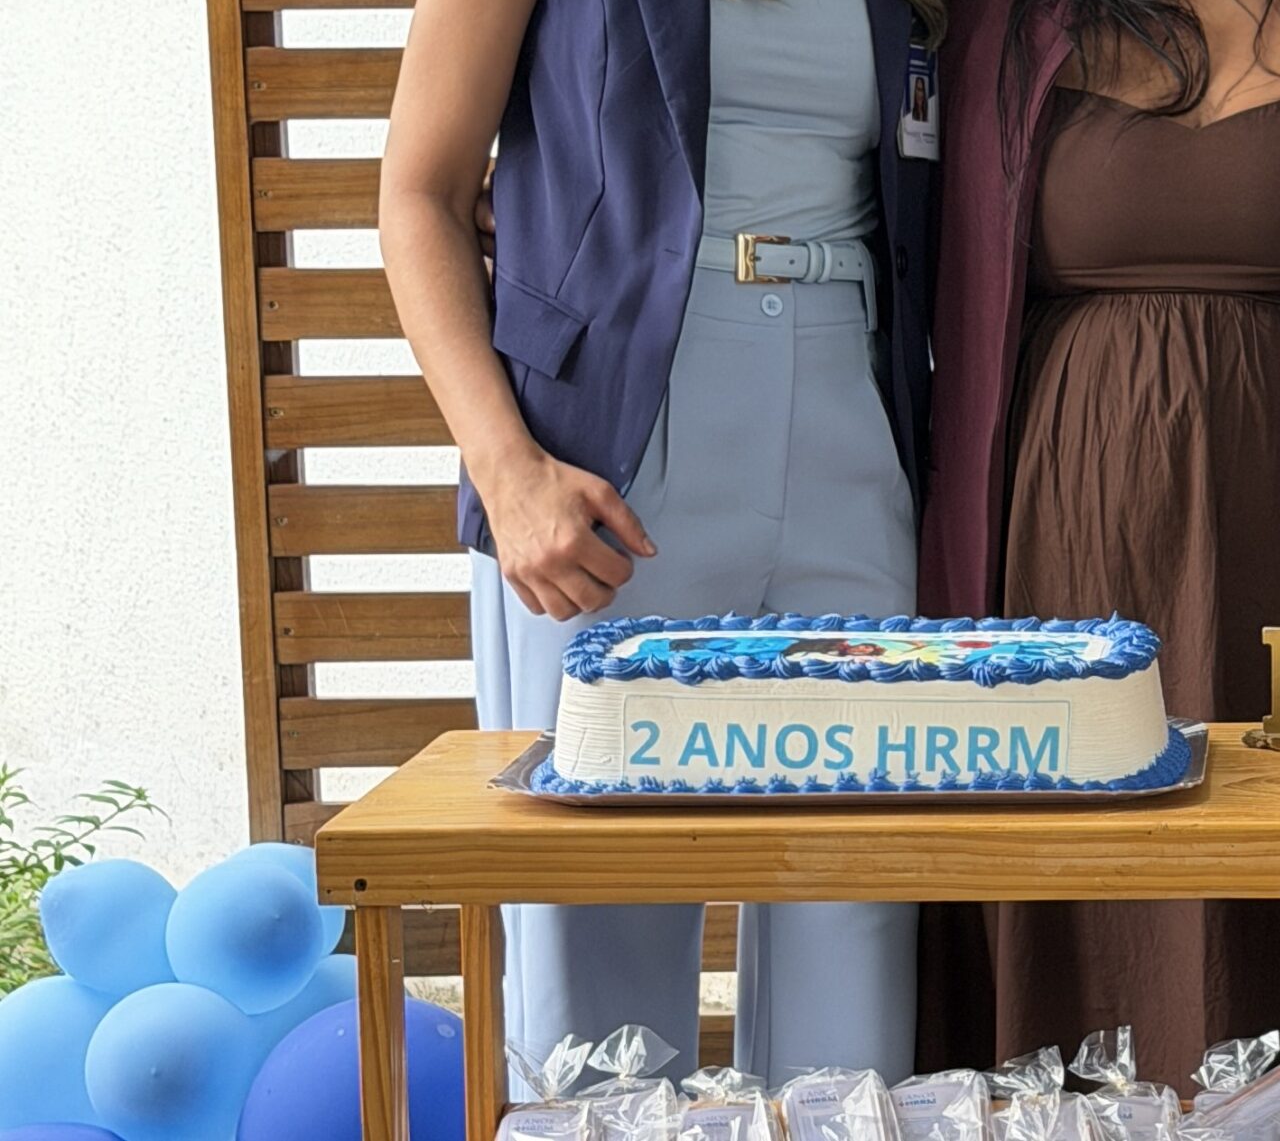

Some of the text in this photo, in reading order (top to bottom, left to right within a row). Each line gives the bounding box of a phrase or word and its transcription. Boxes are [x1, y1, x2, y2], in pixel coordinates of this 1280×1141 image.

[629, 720, 1060, 774] 2 ANOS HRRM
